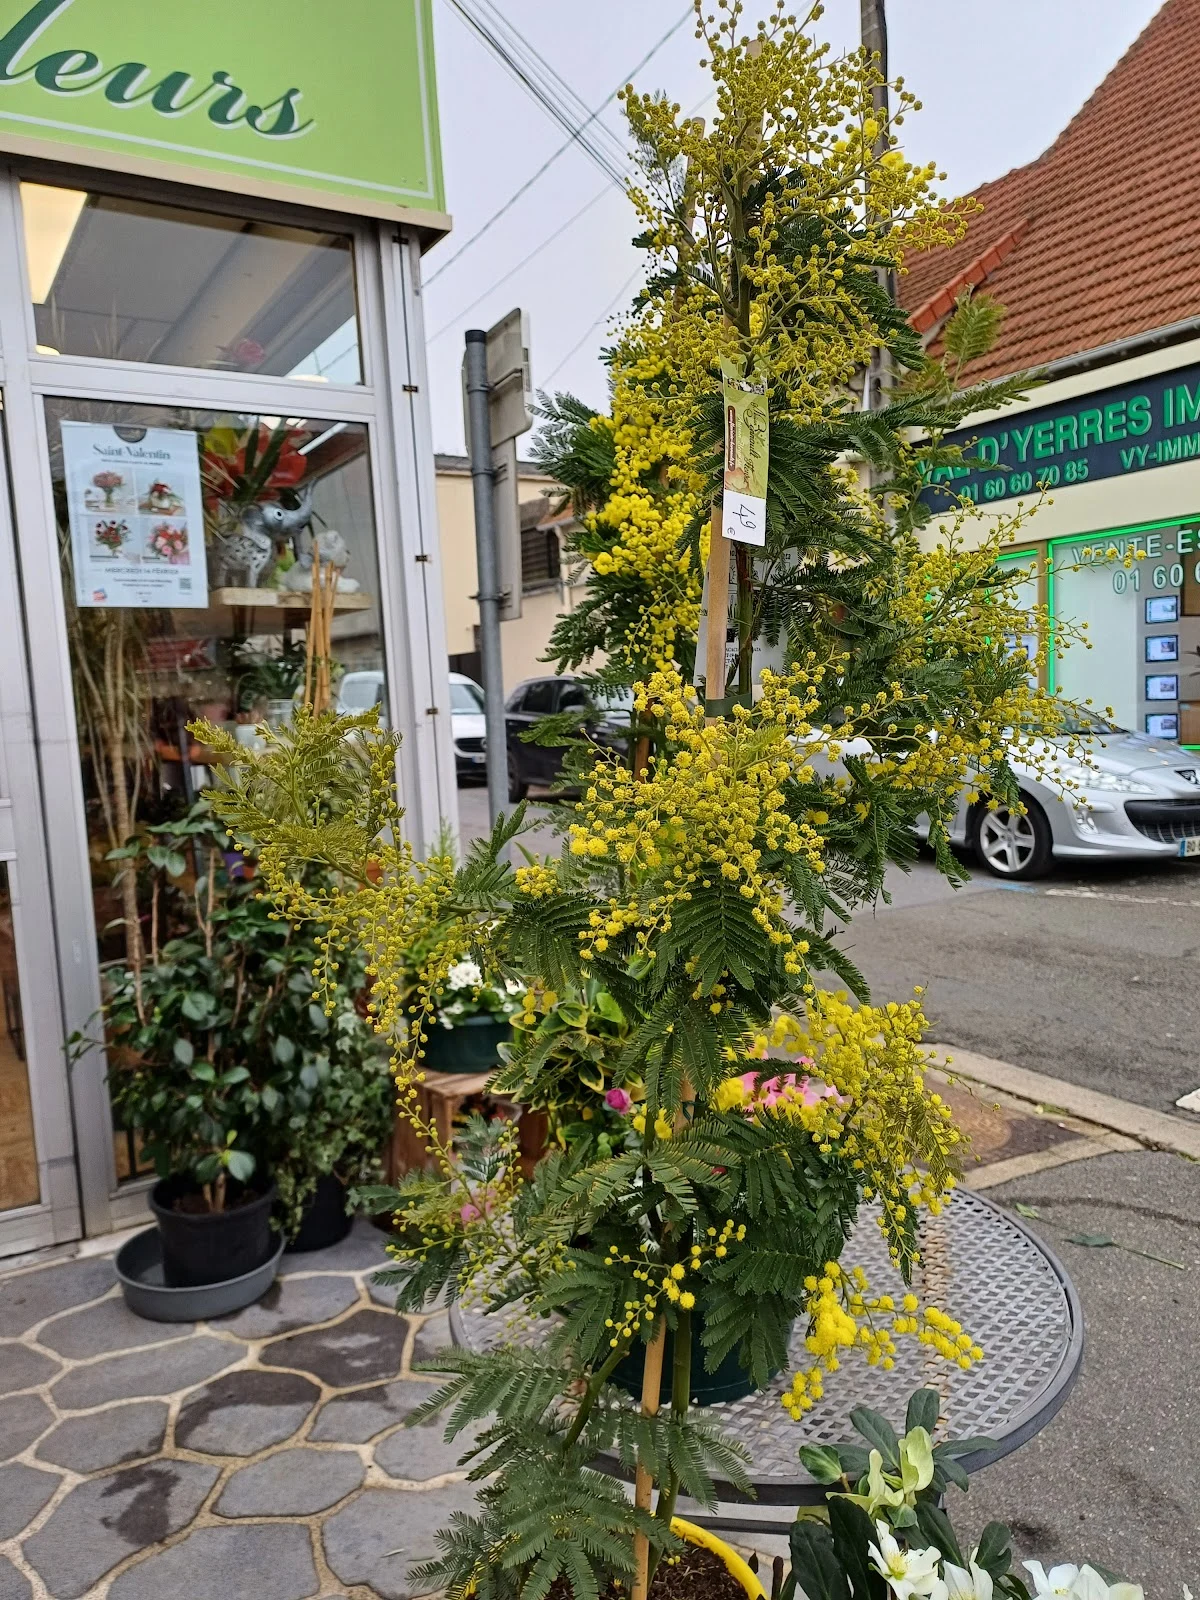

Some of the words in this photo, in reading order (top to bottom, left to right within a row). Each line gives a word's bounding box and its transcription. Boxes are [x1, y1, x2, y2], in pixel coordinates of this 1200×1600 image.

[977, 395, 1152, 470] D'YERRES
[983, 476, 1006, 500] 60
[1009, 471, 1032, 495] 60
[1036, 465, 1060, 488] 70
[1064, 458, 1089, 482] 85
[732, 503, 757, 529] 49
[1072, 529, 1200, 566] VENTE-E
[1112, 568, 1140, 594] 01
[1152, 563, 1184, 590] 60
